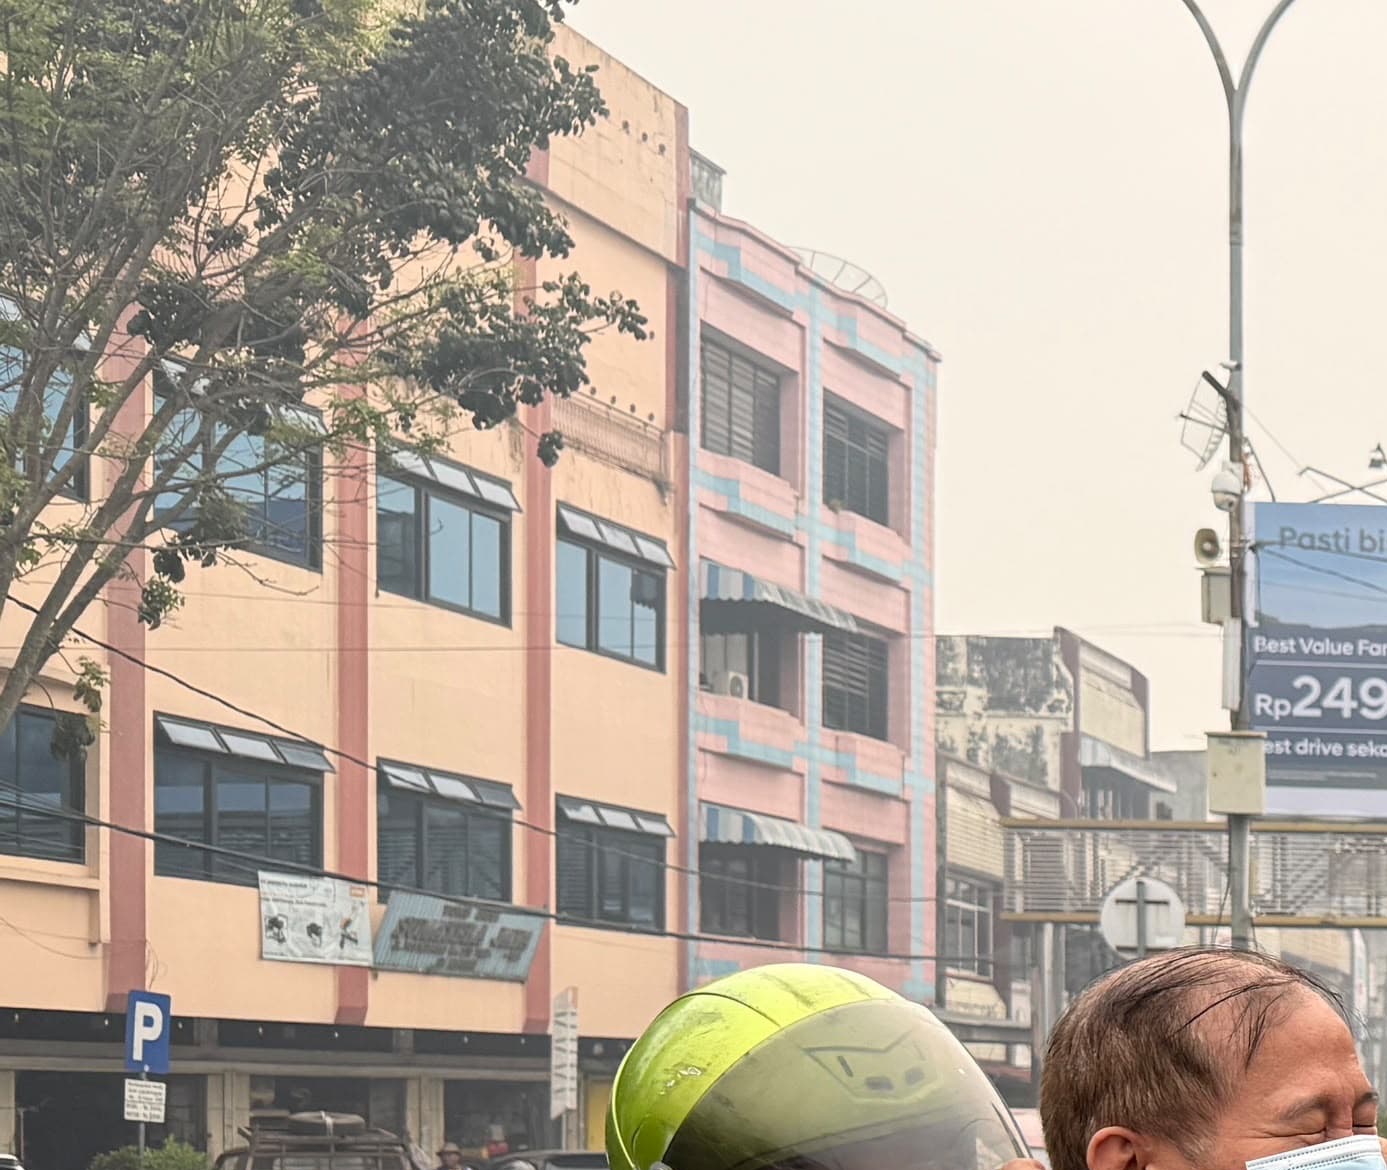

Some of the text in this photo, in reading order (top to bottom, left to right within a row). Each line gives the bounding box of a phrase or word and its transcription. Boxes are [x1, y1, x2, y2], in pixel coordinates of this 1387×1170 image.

[1279, 526, 1350, 554] Pasti
[1254, 635, 1295, 655] Best
[1299, 637, 1353, 657] Value
[1264, 738, 1291, 756] est
[1296, 737, 1343, 757] drive
[132, 1001, 163, 1062] P
